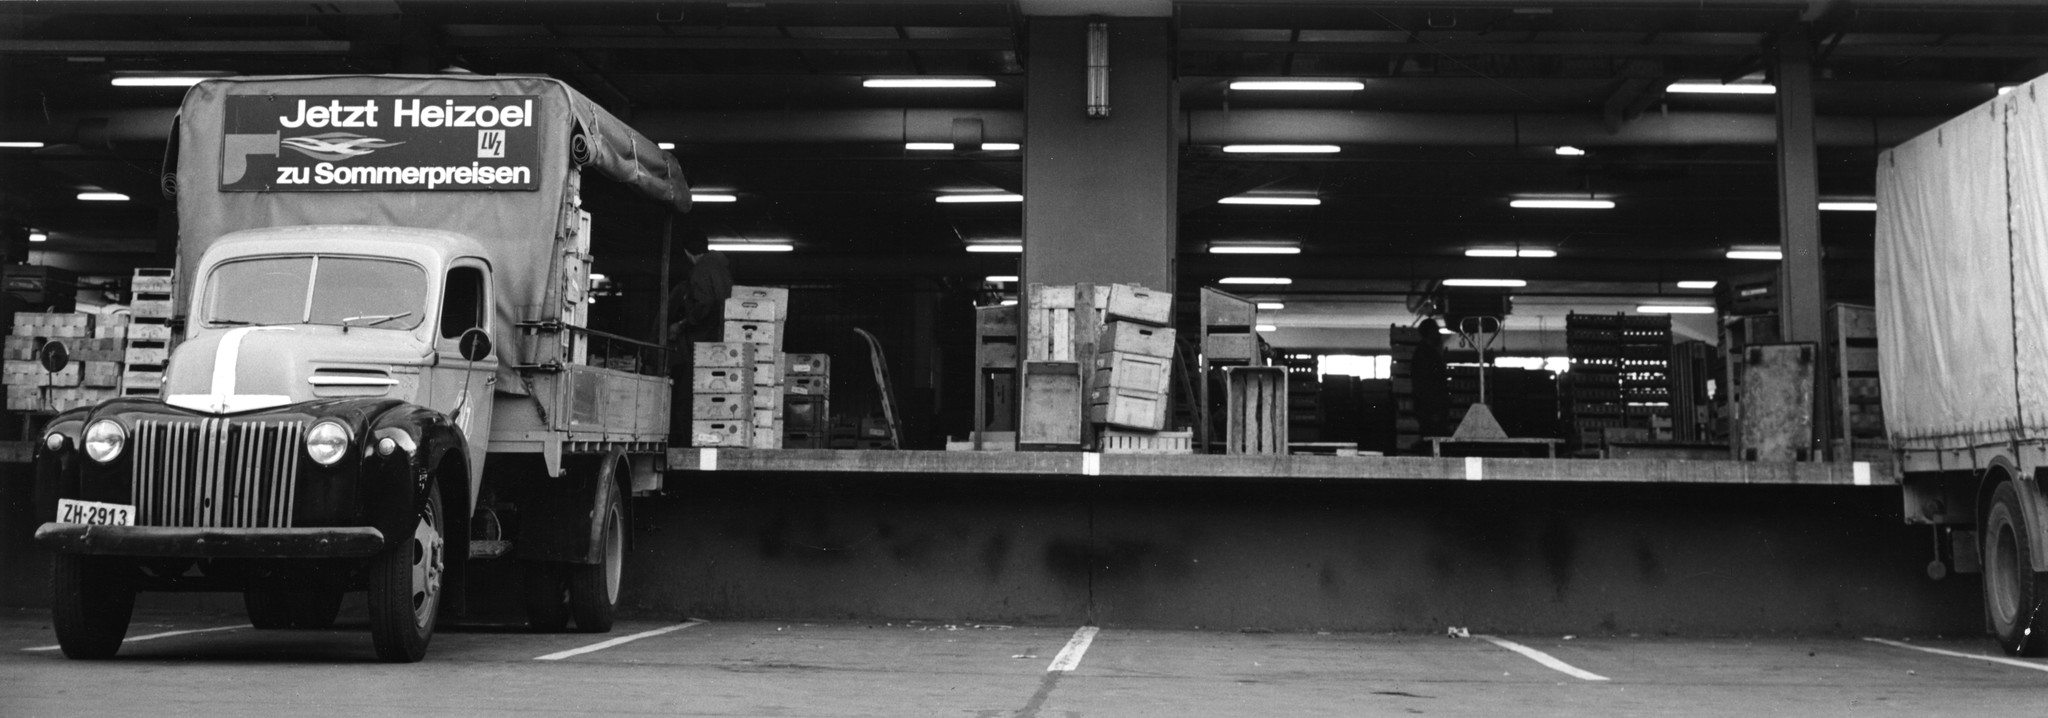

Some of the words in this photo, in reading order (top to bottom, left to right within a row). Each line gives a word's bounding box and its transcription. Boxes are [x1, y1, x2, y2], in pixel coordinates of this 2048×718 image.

[280, 99, 378, 128] Jetzt
[394, 98, 533, 128] Heizoel
[481, 132, 501, 156] LVZ
[277, 166, 310, 185] zu
[314, 161, 531, 190] Sommerpreisen
